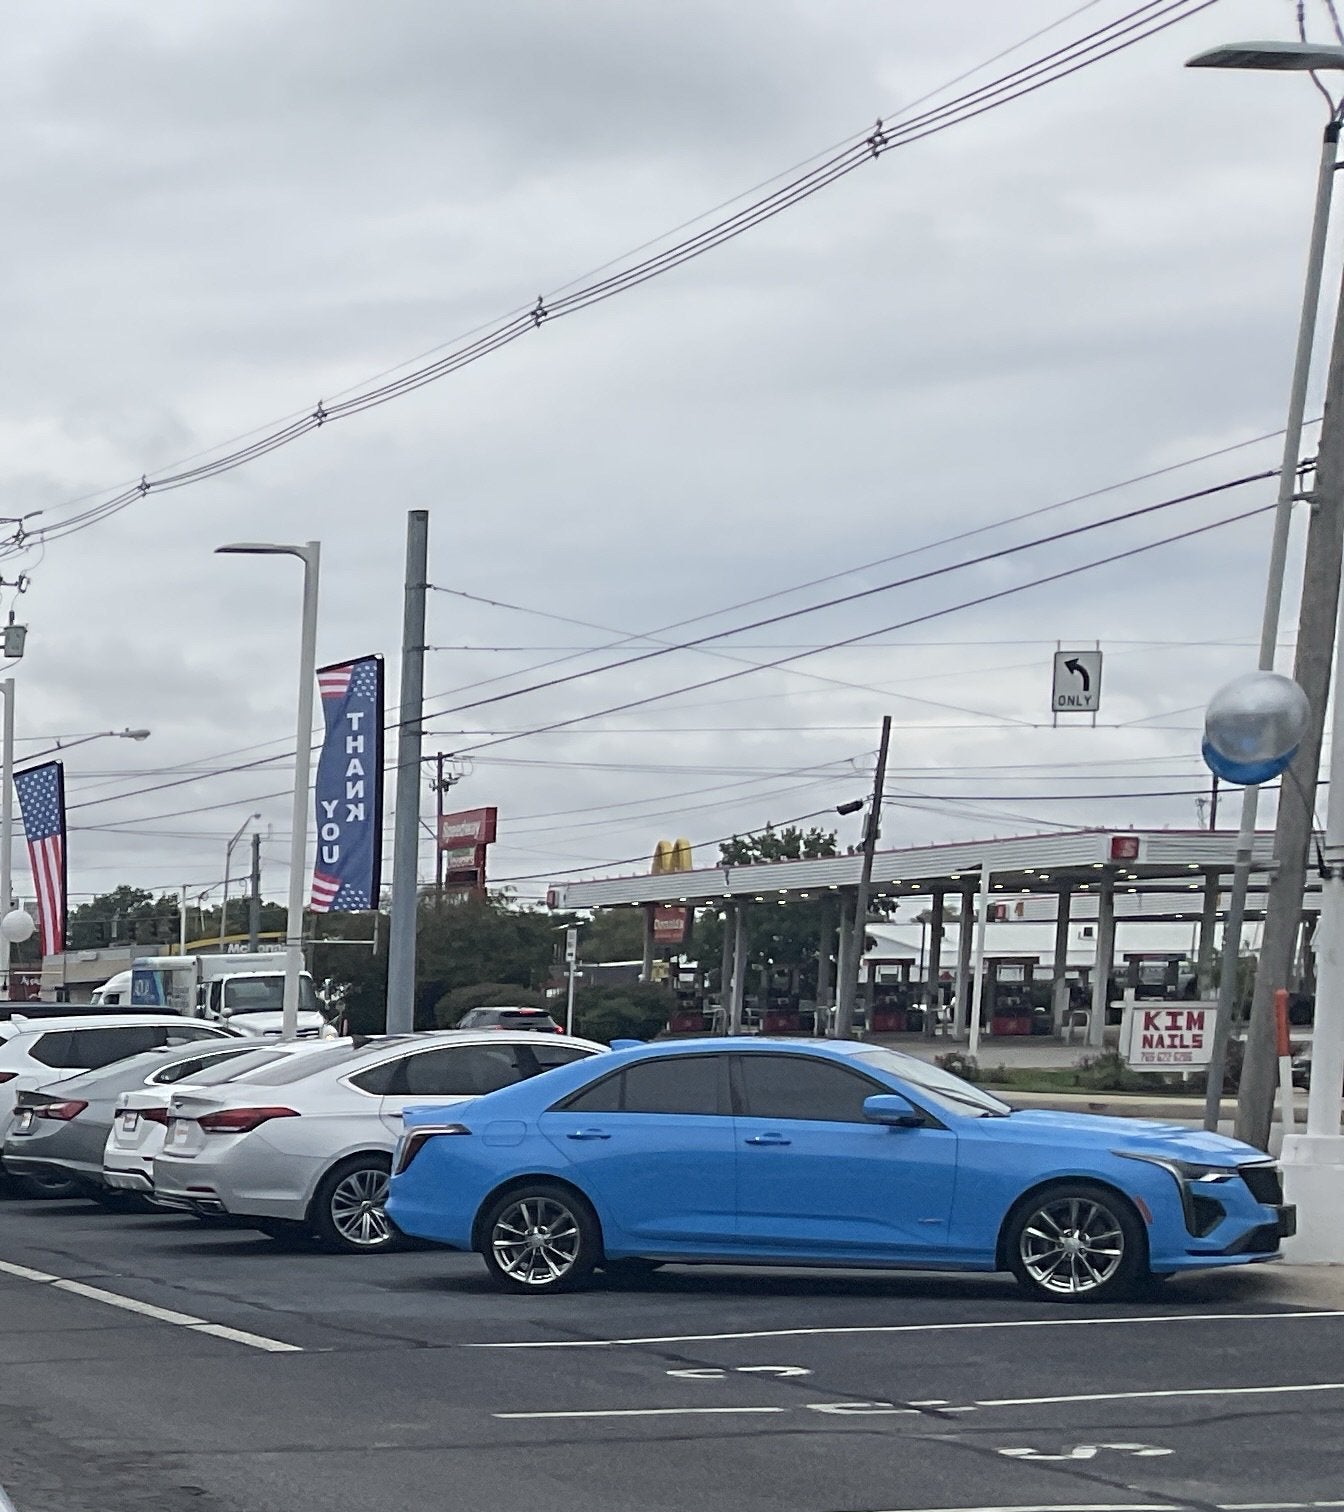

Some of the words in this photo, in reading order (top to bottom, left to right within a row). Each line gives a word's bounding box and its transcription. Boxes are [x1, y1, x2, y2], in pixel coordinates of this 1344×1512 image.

[1058, 695, 1092, 707] ONLY
[1143, 1010, 1205, 1031] KIM
[1141, 1033, 1203, 1049] NAILS
